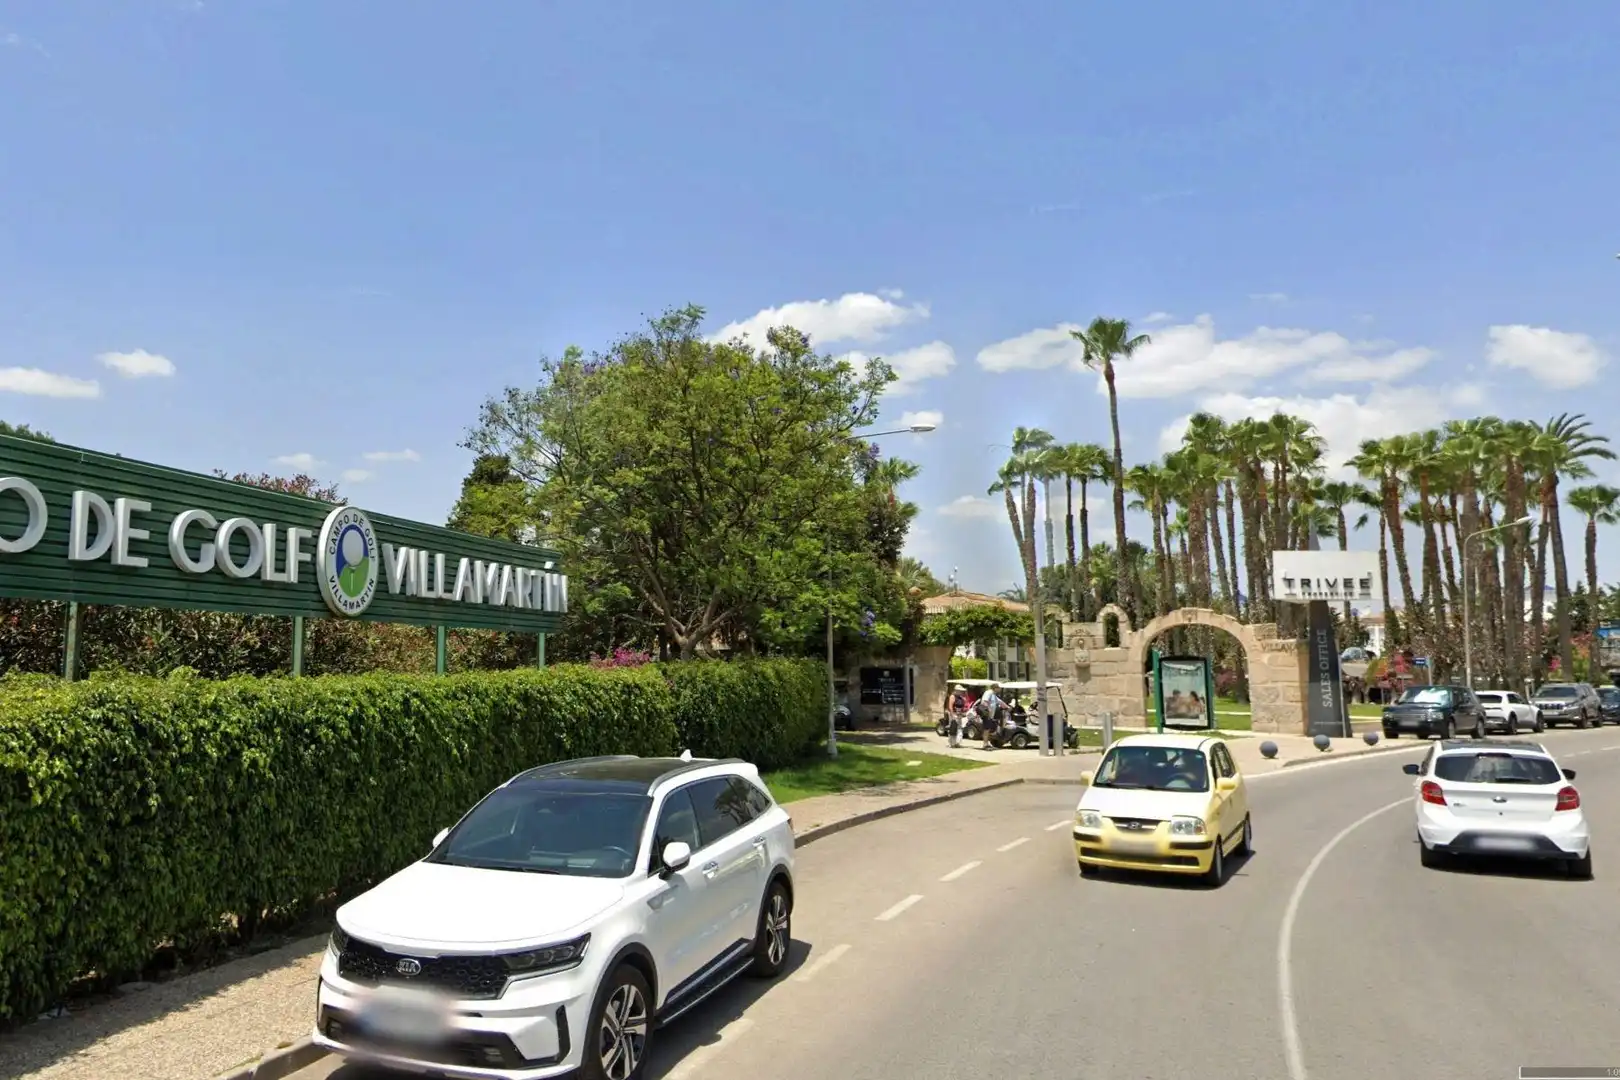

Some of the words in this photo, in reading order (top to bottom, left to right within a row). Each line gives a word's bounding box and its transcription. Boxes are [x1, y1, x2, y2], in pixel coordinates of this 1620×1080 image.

[68, 490, 152, 568] DE
[168, 509, 313, 584] GOLF
[381, 543, 568, 613] VILLAMARTÍN
[330, 514, 349, 555] CAMPO
[353, 513, 364, 527] DE
[329, 576, 375, 611] VILLAMARTIN
[1282, 577, 1371, 589] TRIVEE
[1316, 630, 1329, 670] OFFICE
[1320, 672, 1333, 708] SALES
[399, 961, 417, 973] KIA
